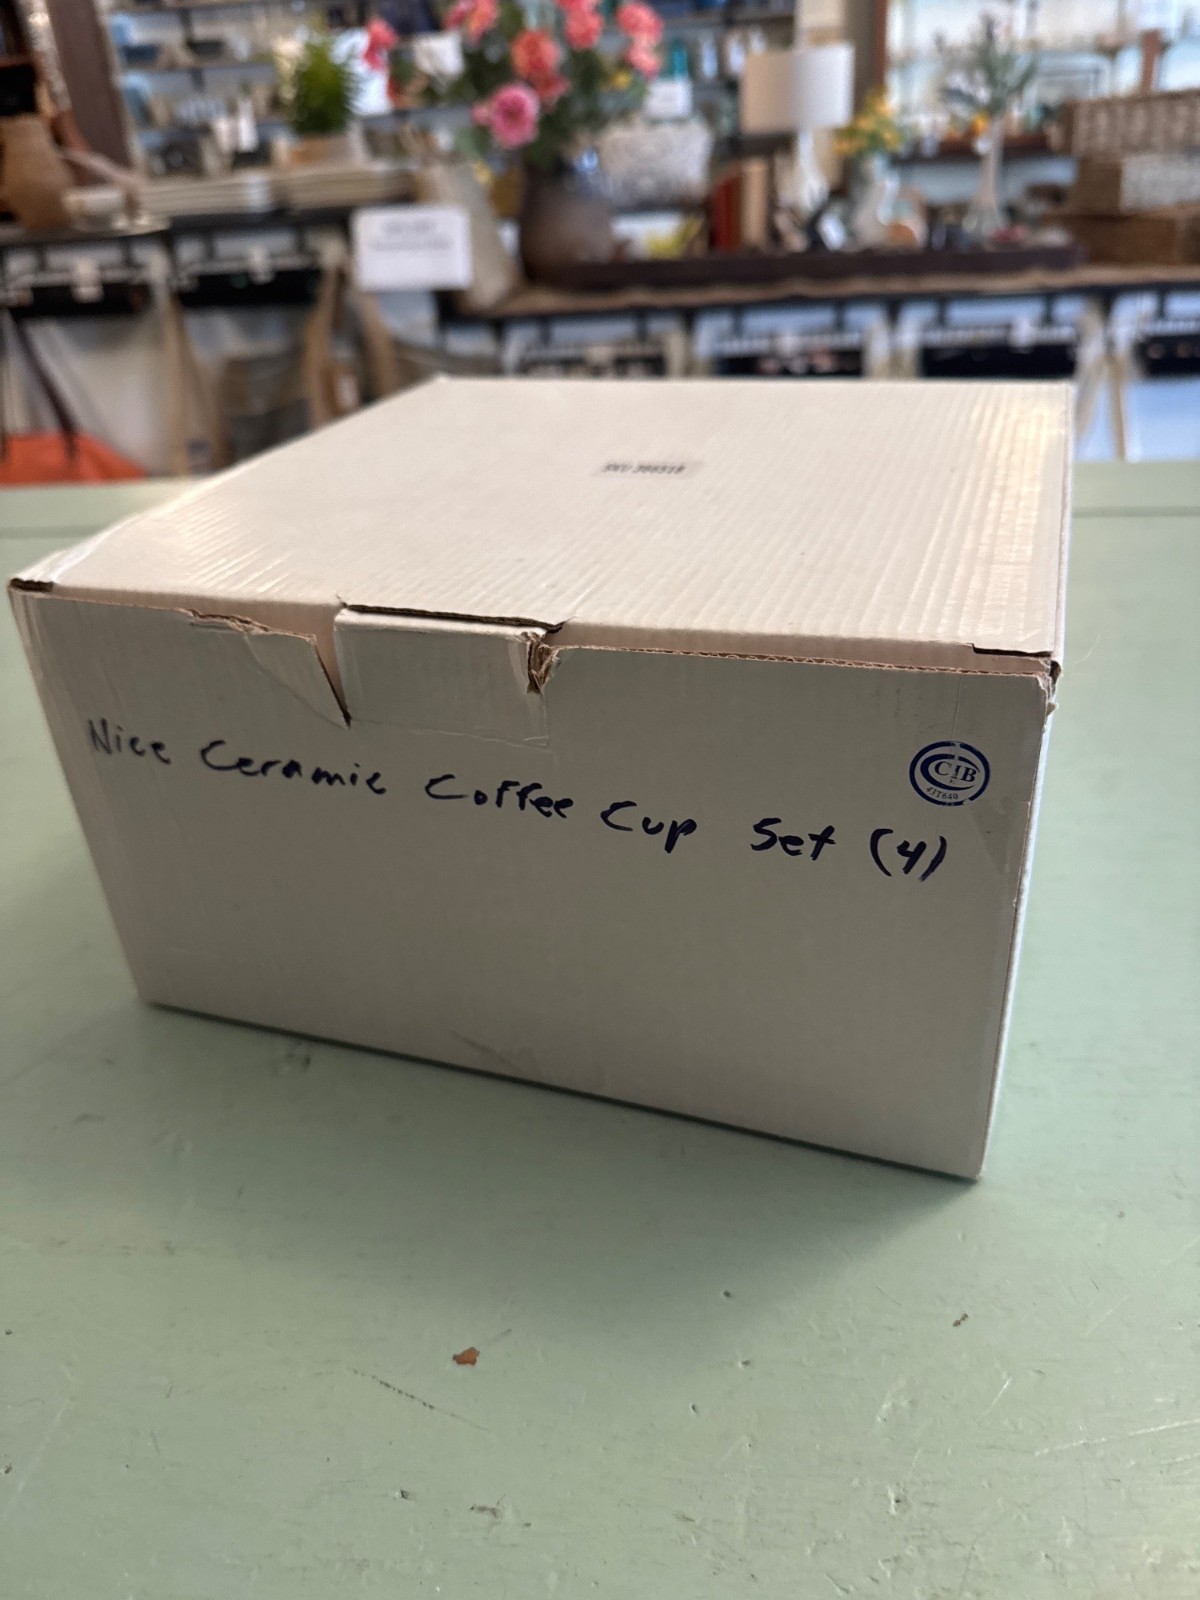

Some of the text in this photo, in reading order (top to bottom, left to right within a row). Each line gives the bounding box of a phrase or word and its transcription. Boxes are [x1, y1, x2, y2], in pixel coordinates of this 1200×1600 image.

[88, 717, 948, 882] Nice Ceramic Coffee Cup Set (4)
[934, 760, 977, 783] CIB
